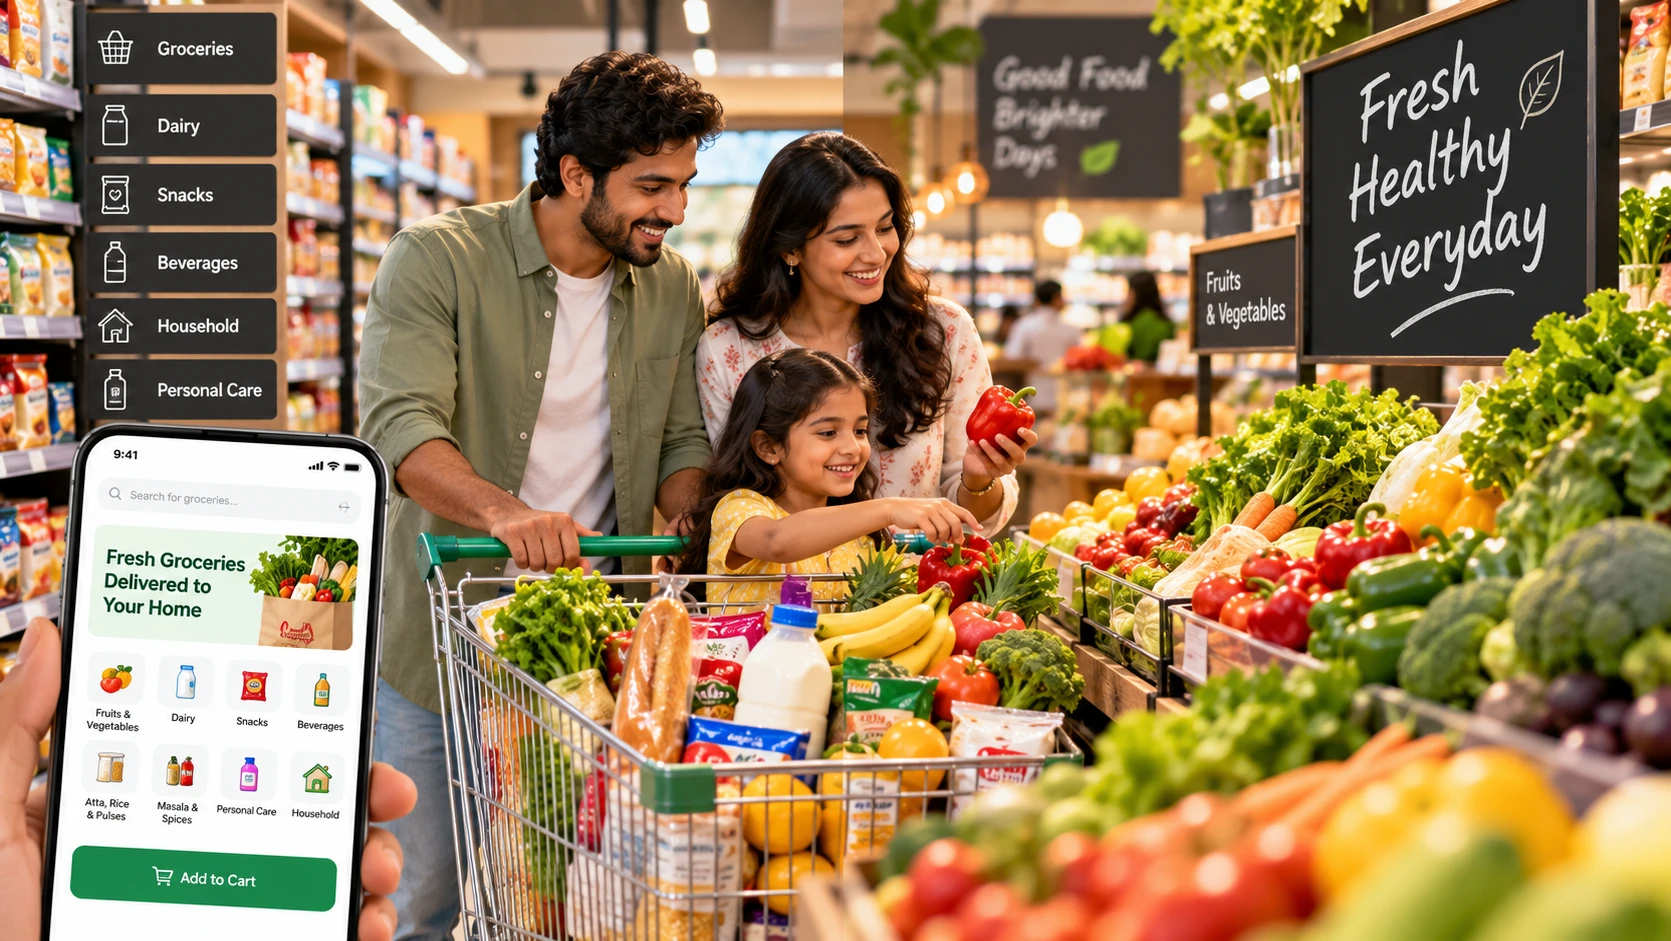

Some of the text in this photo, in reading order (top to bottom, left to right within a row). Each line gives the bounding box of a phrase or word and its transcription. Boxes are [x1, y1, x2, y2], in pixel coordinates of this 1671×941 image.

[158, 41, 233, 56] Groceries
[994, 56, 1150, 92] Good Food
[1359, 38, 1480, 144] Fresh
[993, 97, 1105, 141] Brighter
[158, 118, 200, 137] Dairy
[994, 134, 1056, 177] Days
[1350, 116, 1512, 223] Healthy
[158, 187, 213, 202] Snacks
[1352, 189, 1546, 299] Everyday
[158, 255, 238, 273] Beverages
[1207, 269, 1241, 293] Fruits
[1206, 297, 1286, 330] & Vegetables
[158, 318, 238, 333] Household
[158, 382, 262, 397] Personal Care
[114, 449, 137, 459] 9:41
[129, 490, 165, 502] Search
[168, 493, 182, 502] for
[107, 549, 245, 572] Fresh Groceries
[105, 573, 211, 594] Delivered to
[103, 597, 201, 617] Your Home
[96, 708, 131, 718] Fruits &
[172, 713, 195, 724] Dairy
[87, 721, 139, 732] Vegetables
[237, 717, 268, 726] Snacks
[298, 720, 344, 732] Beverages
[85, 798, 129, 808] Atta, Rice
[157, 802, 198, 812] Masala &
[217, 805, 277, 816] Personal Care
[87, 811, 126, 821] & Pulses
[162, 814, 192, 825] Spices
[292, 809, 340, 819] Household
[180, 872, 256, 887] Add to Cart
